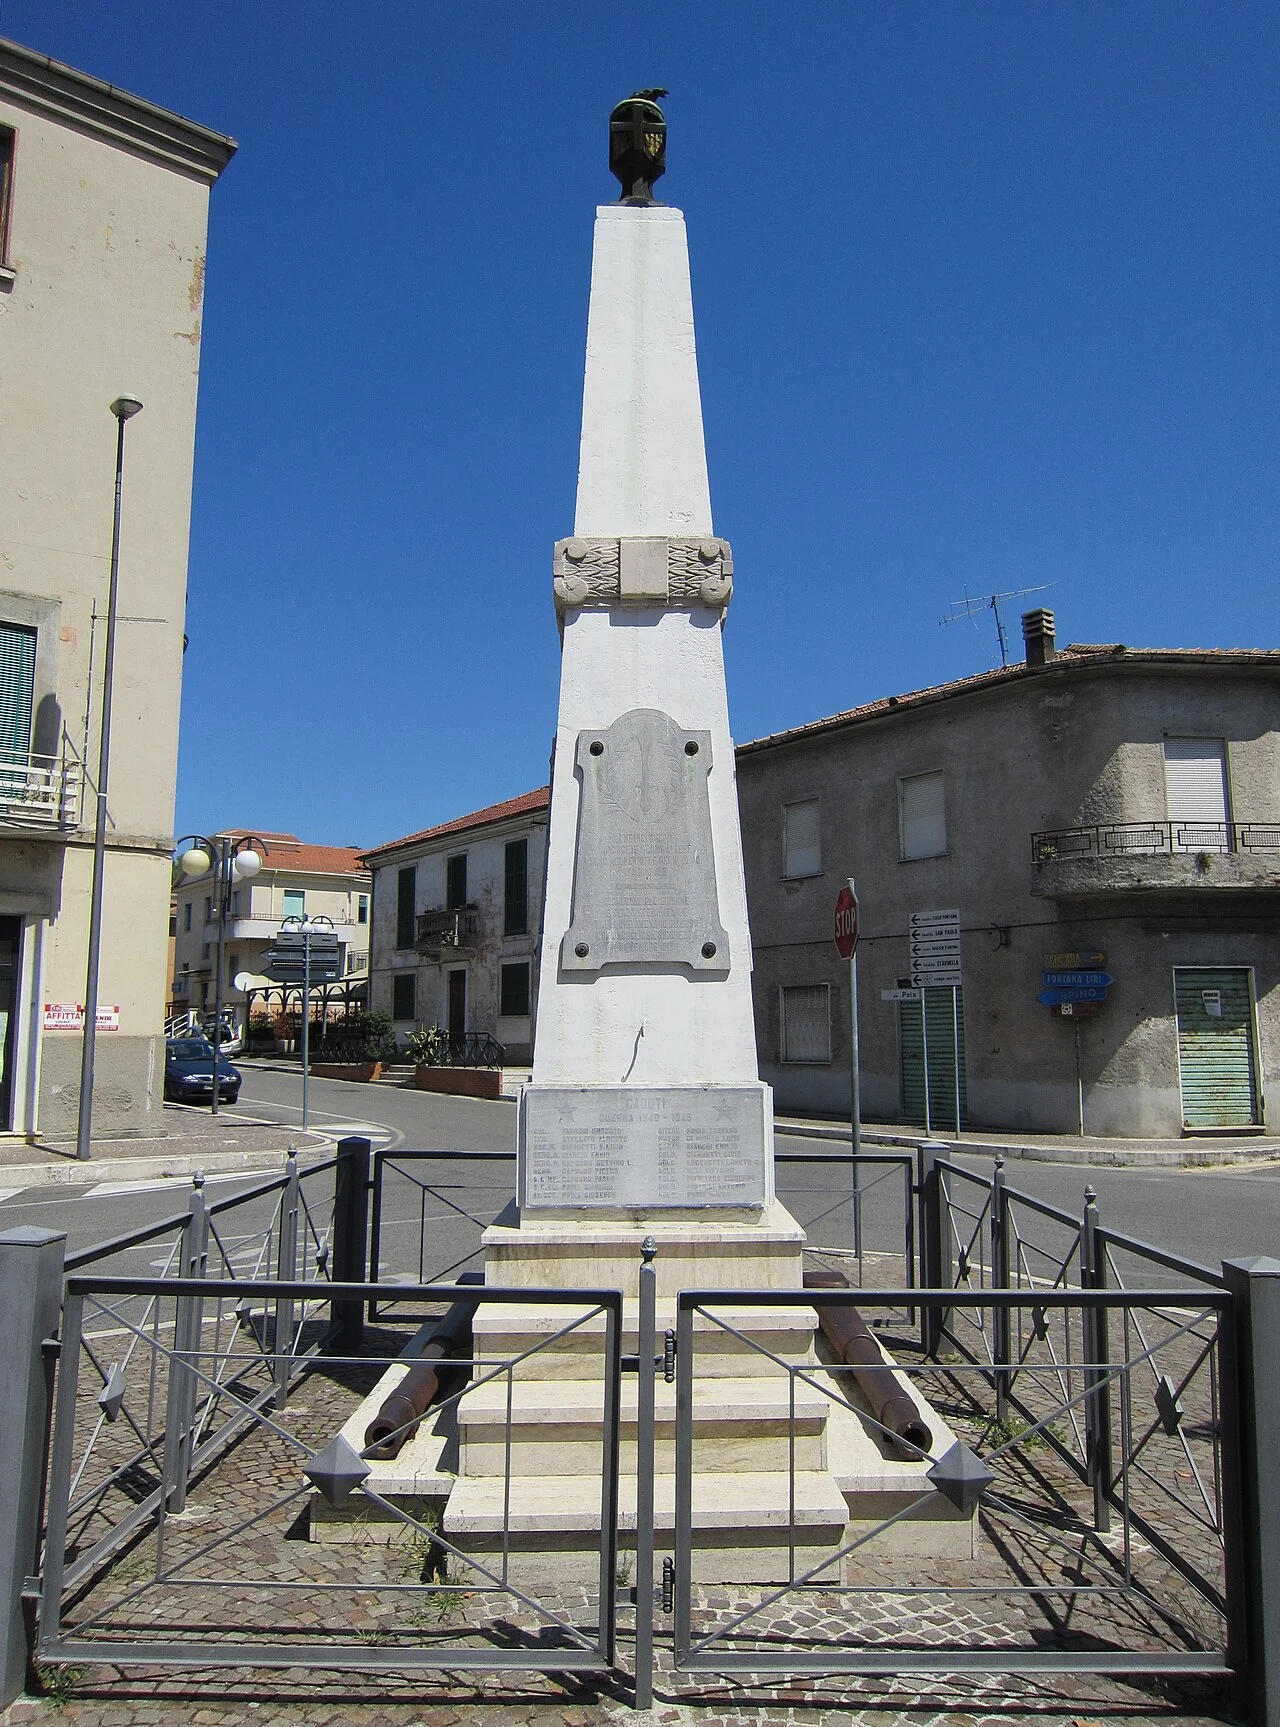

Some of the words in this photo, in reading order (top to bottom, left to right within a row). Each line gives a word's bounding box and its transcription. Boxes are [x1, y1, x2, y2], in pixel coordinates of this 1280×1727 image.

[835, 907, 855, 938] STOP
[1047, 974, 1082, 984] FONTANA
[1086, 974, 1102, 984] LIRI
[1059, 988, 1096, 1000] RPINO
[626, 1097, 666, 1110] CADUTI
[599, 1112, 634, 1123] GUERRA
[671, 1112, 693, 1123] 1945
